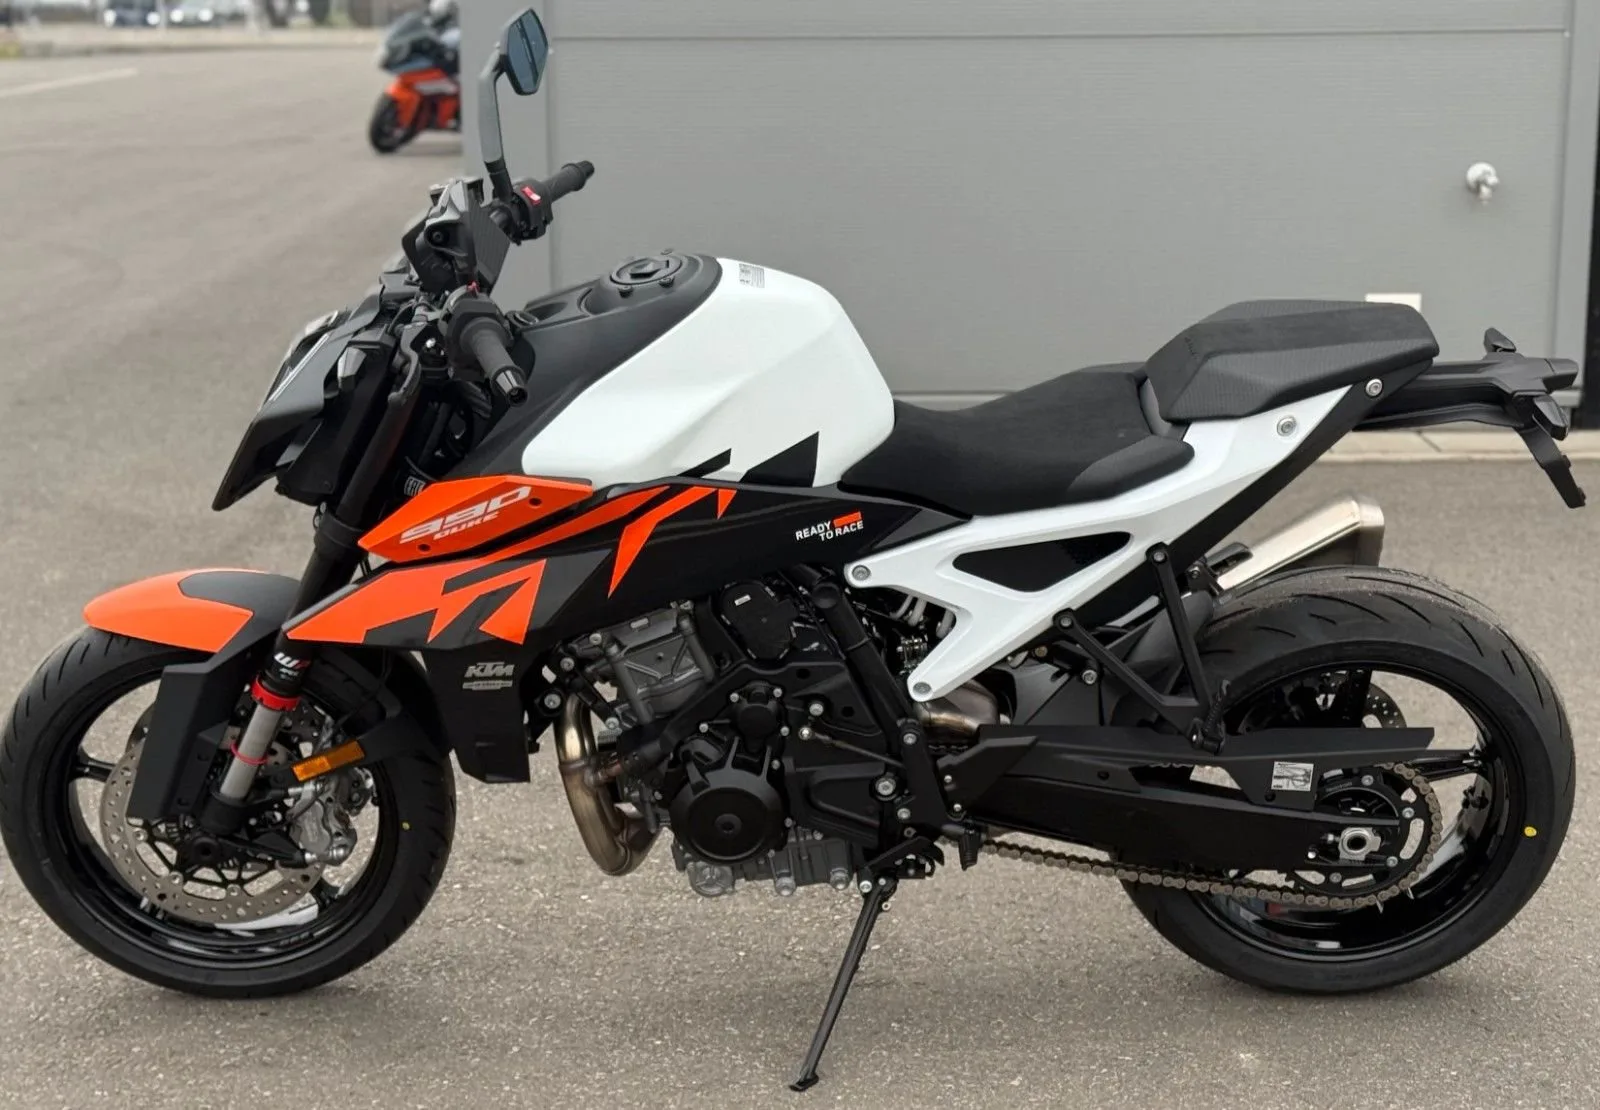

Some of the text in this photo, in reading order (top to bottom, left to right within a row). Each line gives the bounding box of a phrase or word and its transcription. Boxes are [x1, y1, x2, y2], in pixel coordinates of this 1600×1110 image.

[400, 486, 532, 544] 990
[433, 511, 501, 540] DUKE
[795, 520, 831, 541] READY
[819, 520, 864, 541] TO RACE
[463, 661, 515, 678] KTM
